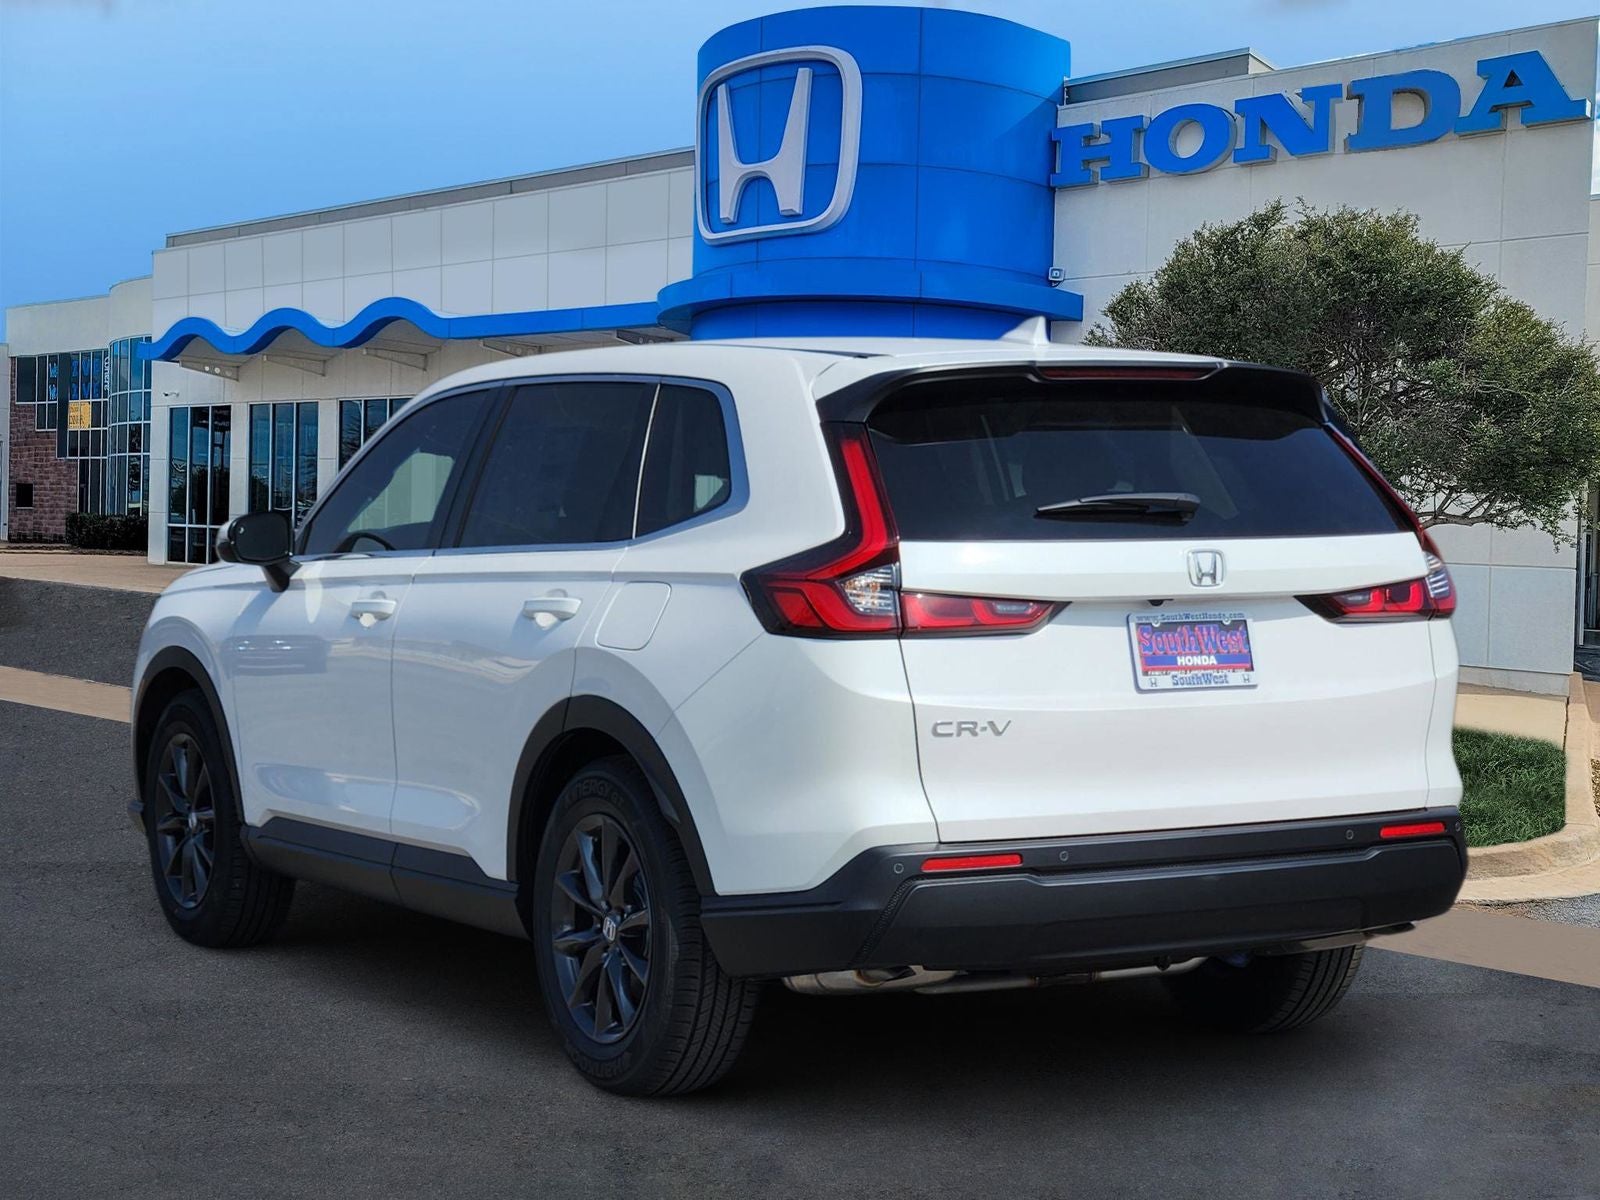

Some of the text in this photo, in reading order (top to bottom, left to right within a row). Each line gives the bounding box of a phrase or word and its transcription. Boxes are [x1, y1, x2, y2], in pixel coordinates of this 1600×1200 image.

[1050, 49, 1593, 188] HONDA
[1138, 624, 1249, 655] SouthWest
[1176, 655, 1217, 666] HONDA
[1172, 673, 1229, 686] SouthWest
[931, 720, 1011, 738] CR-V
